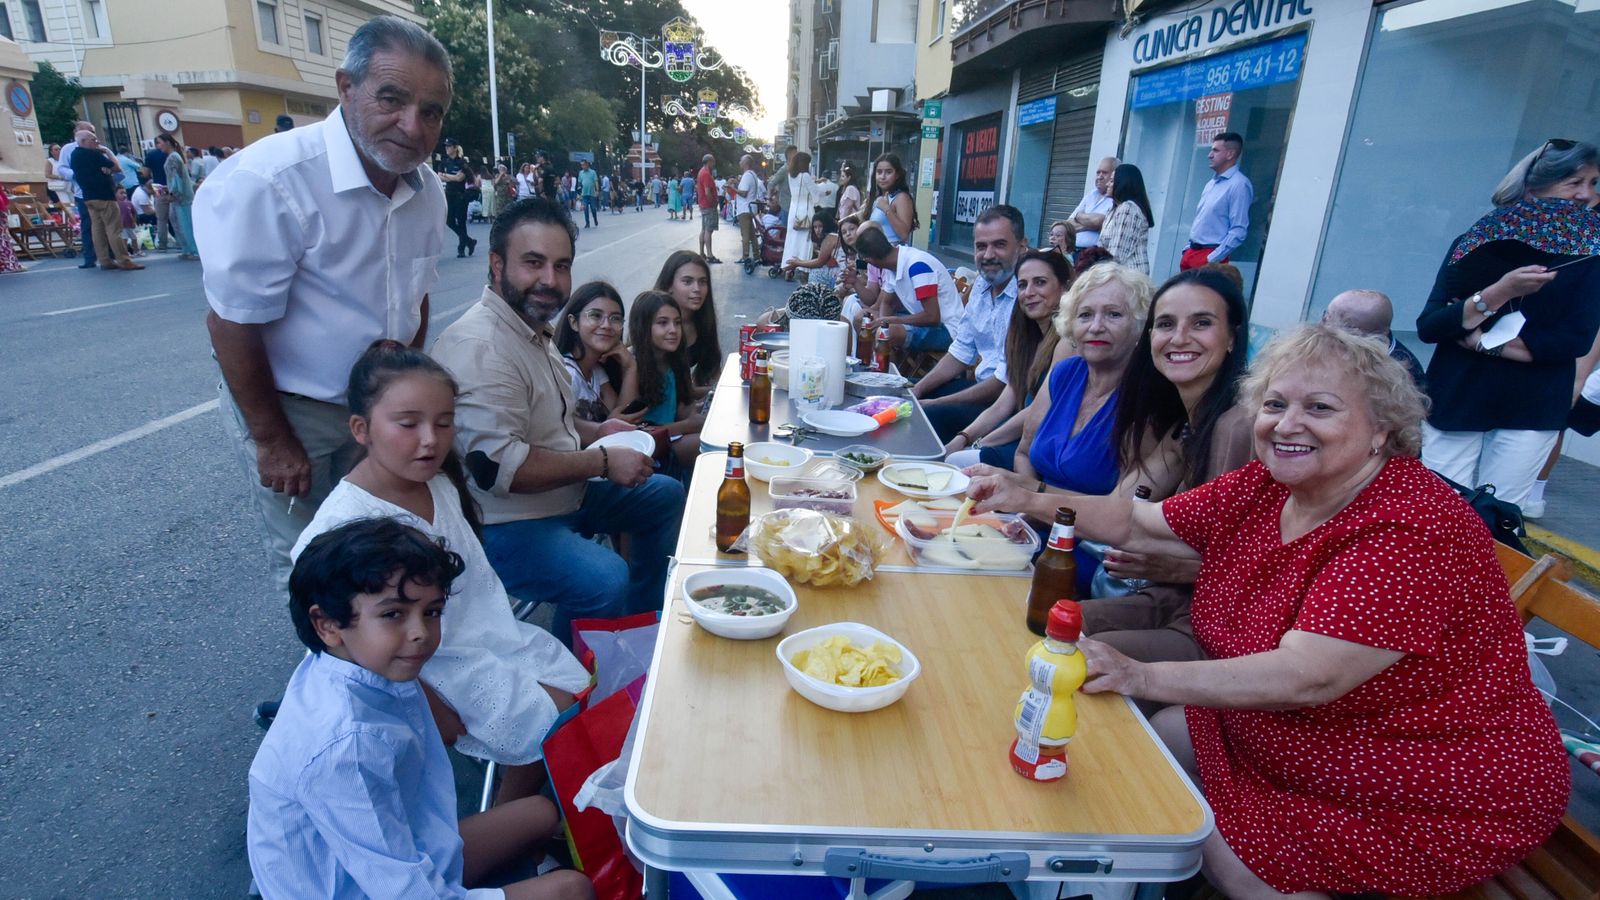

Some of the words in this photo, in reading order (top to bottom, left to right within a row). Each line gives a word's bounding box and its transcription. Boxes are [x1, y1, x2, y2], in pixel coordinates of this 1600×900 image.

[1133, 16, 1202, 64] CLINICA
[1206, 64, 1230, 88] 956
[1233, 59, 1250, 83] 76
[1253, 54, 1271, 77] 41
[1278, 48, 1297, 73] 12
[966, 132, 975, 154] EN
[976, 127, 997, 153] VENTA
